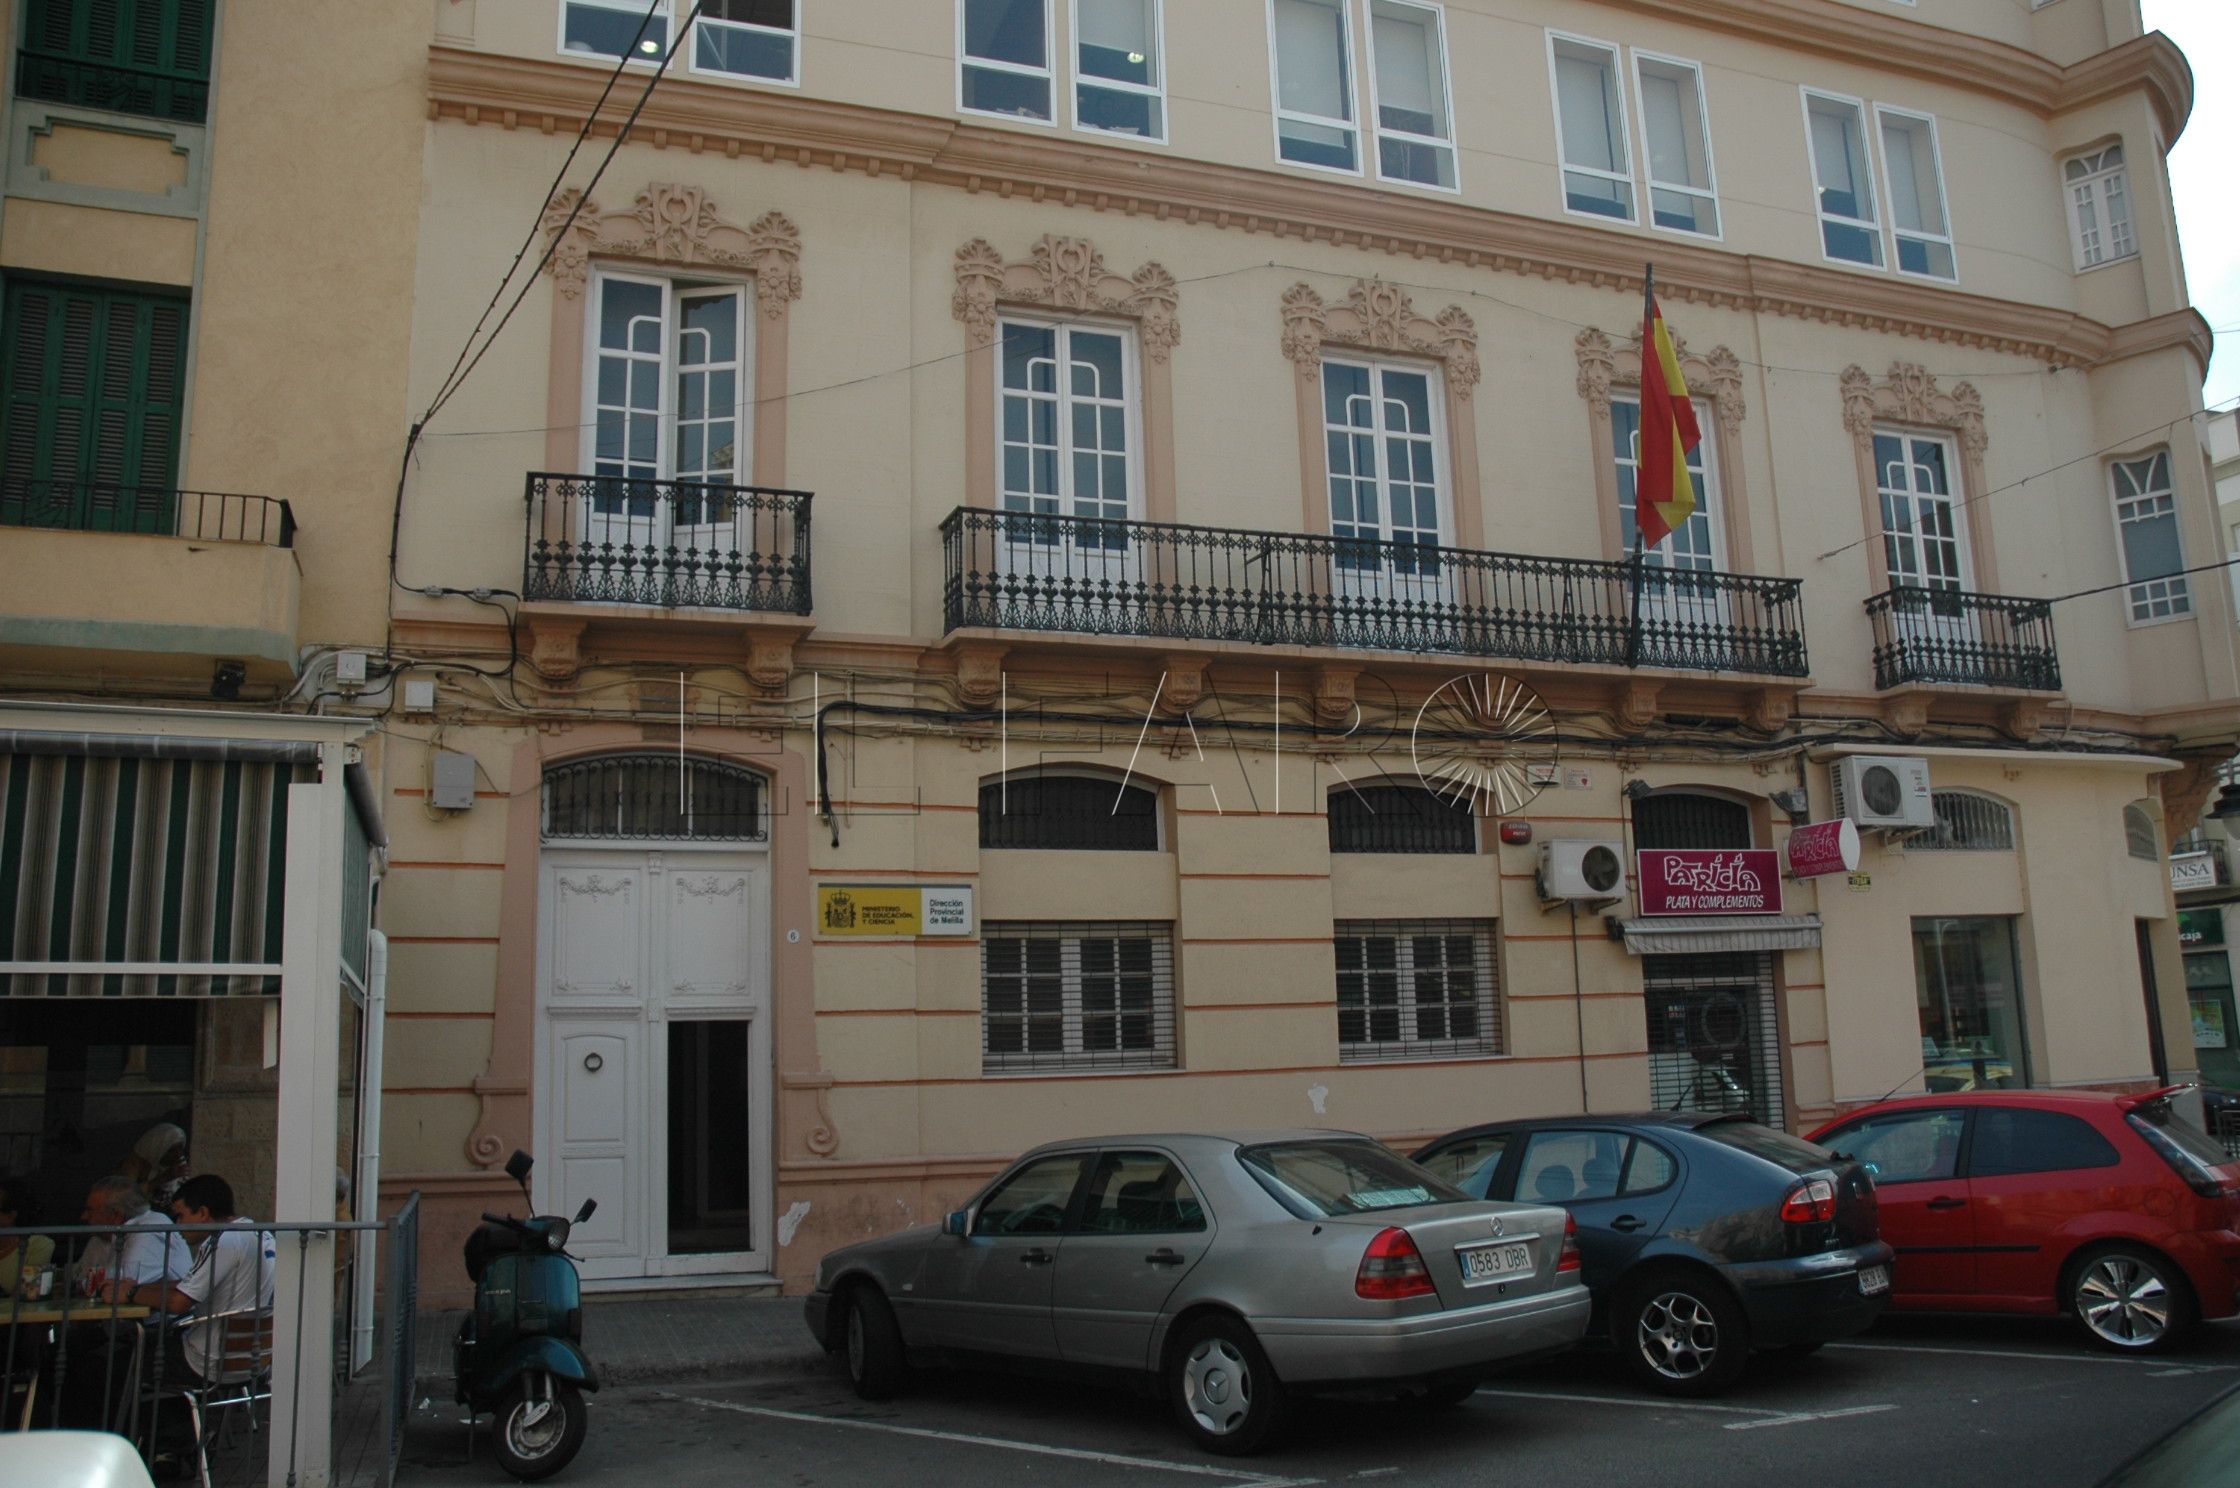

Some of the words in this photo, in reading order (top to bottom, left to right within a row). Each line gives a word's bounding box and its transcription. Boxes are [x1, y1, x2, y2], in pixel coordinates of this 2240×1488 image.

[930, 899, 963, 907] Dirección
[1666, 895, 1690, 909] PLATA
[1691, 895, 1698, 909] Y
[1698, 895, 1764, 909] COMPLEMENTOS
[930, 908, 964, 916] Provincial
[930, 916, 938, 924] de
[941, 916, 964, 924] Melilla
[1469, 1251, 1501, 1273] 0583
[1505, 1248, 1529, 1268] DBR
